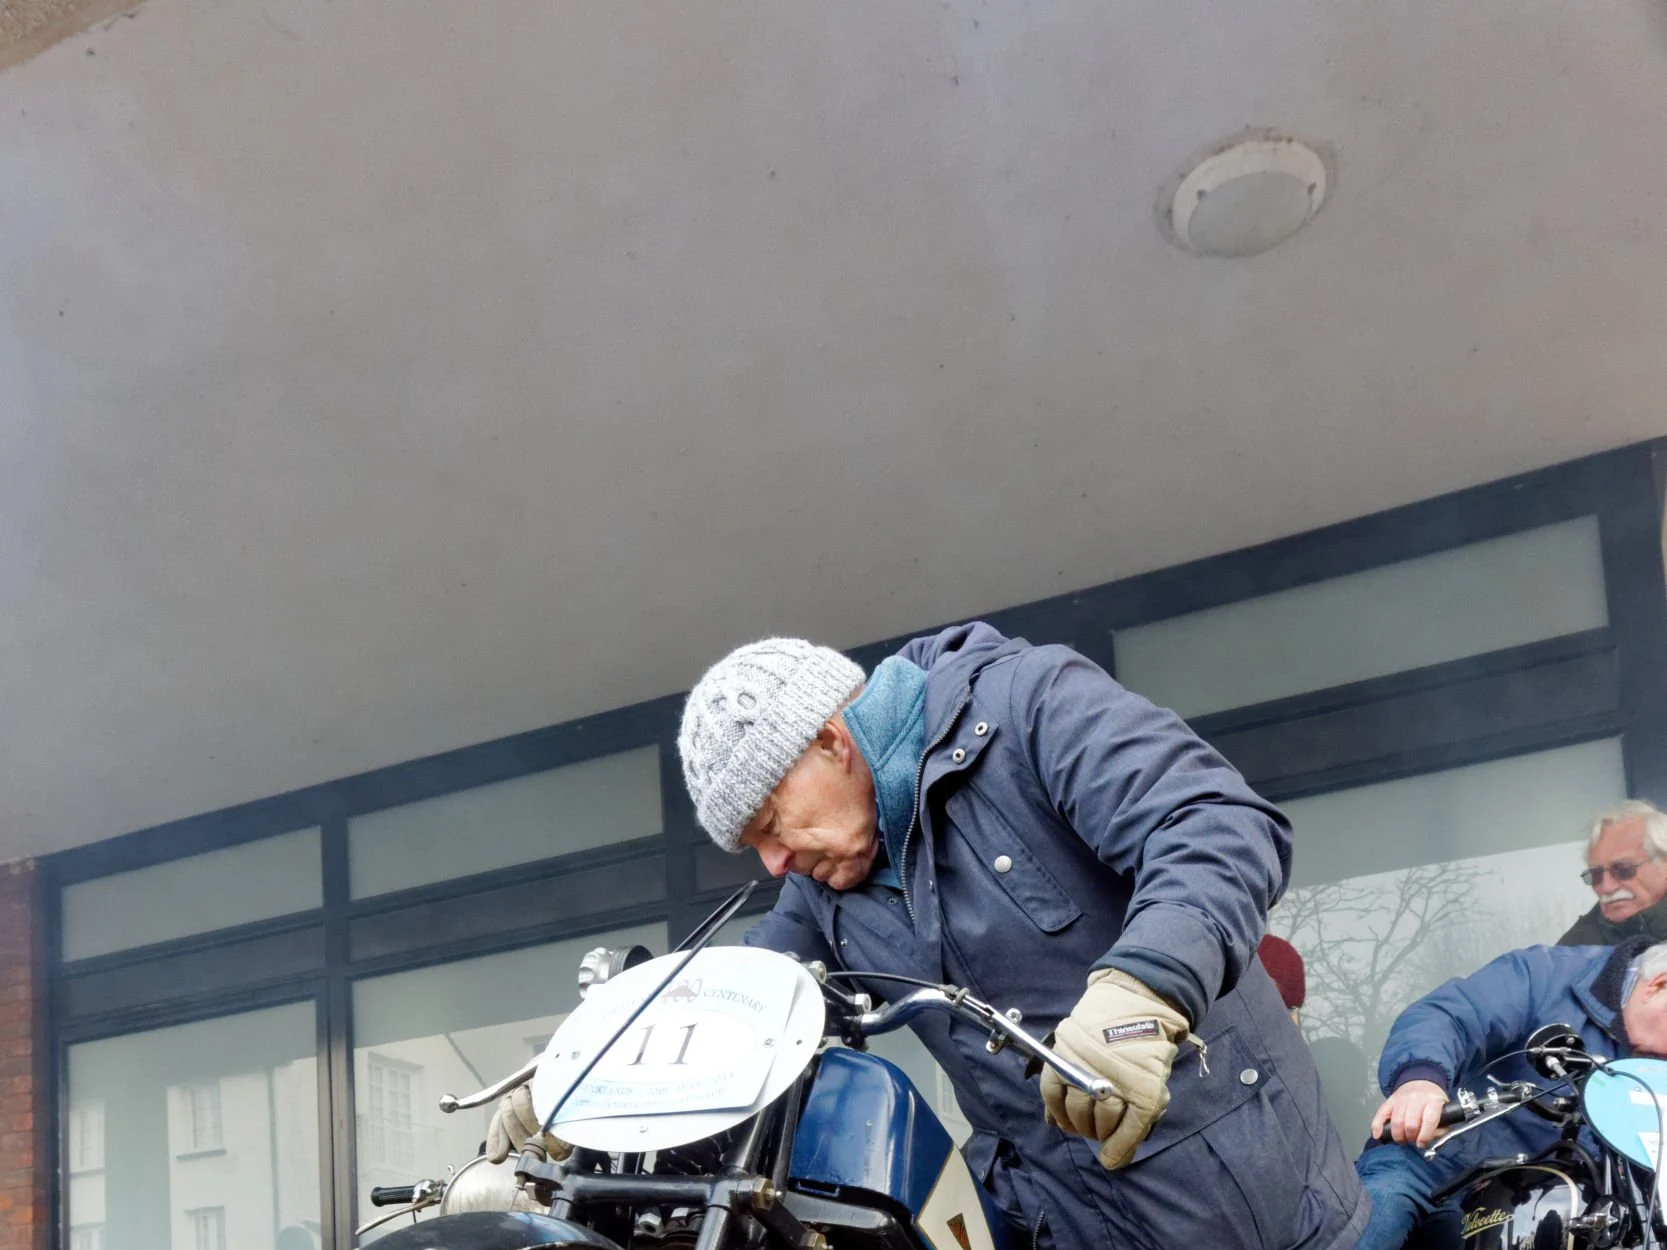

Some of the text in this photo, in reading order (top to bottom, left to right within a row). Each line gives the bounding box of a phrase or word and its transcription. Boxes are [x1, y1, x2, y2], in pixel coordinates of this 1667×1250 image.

[703, 987, 767, 1013] CENTENARY
[1107, 1021, 1155, 1036] Thinsulate
[627, 1022, 700, 1066] 11
[1461, 1207, 1514, 1237] Velocette
